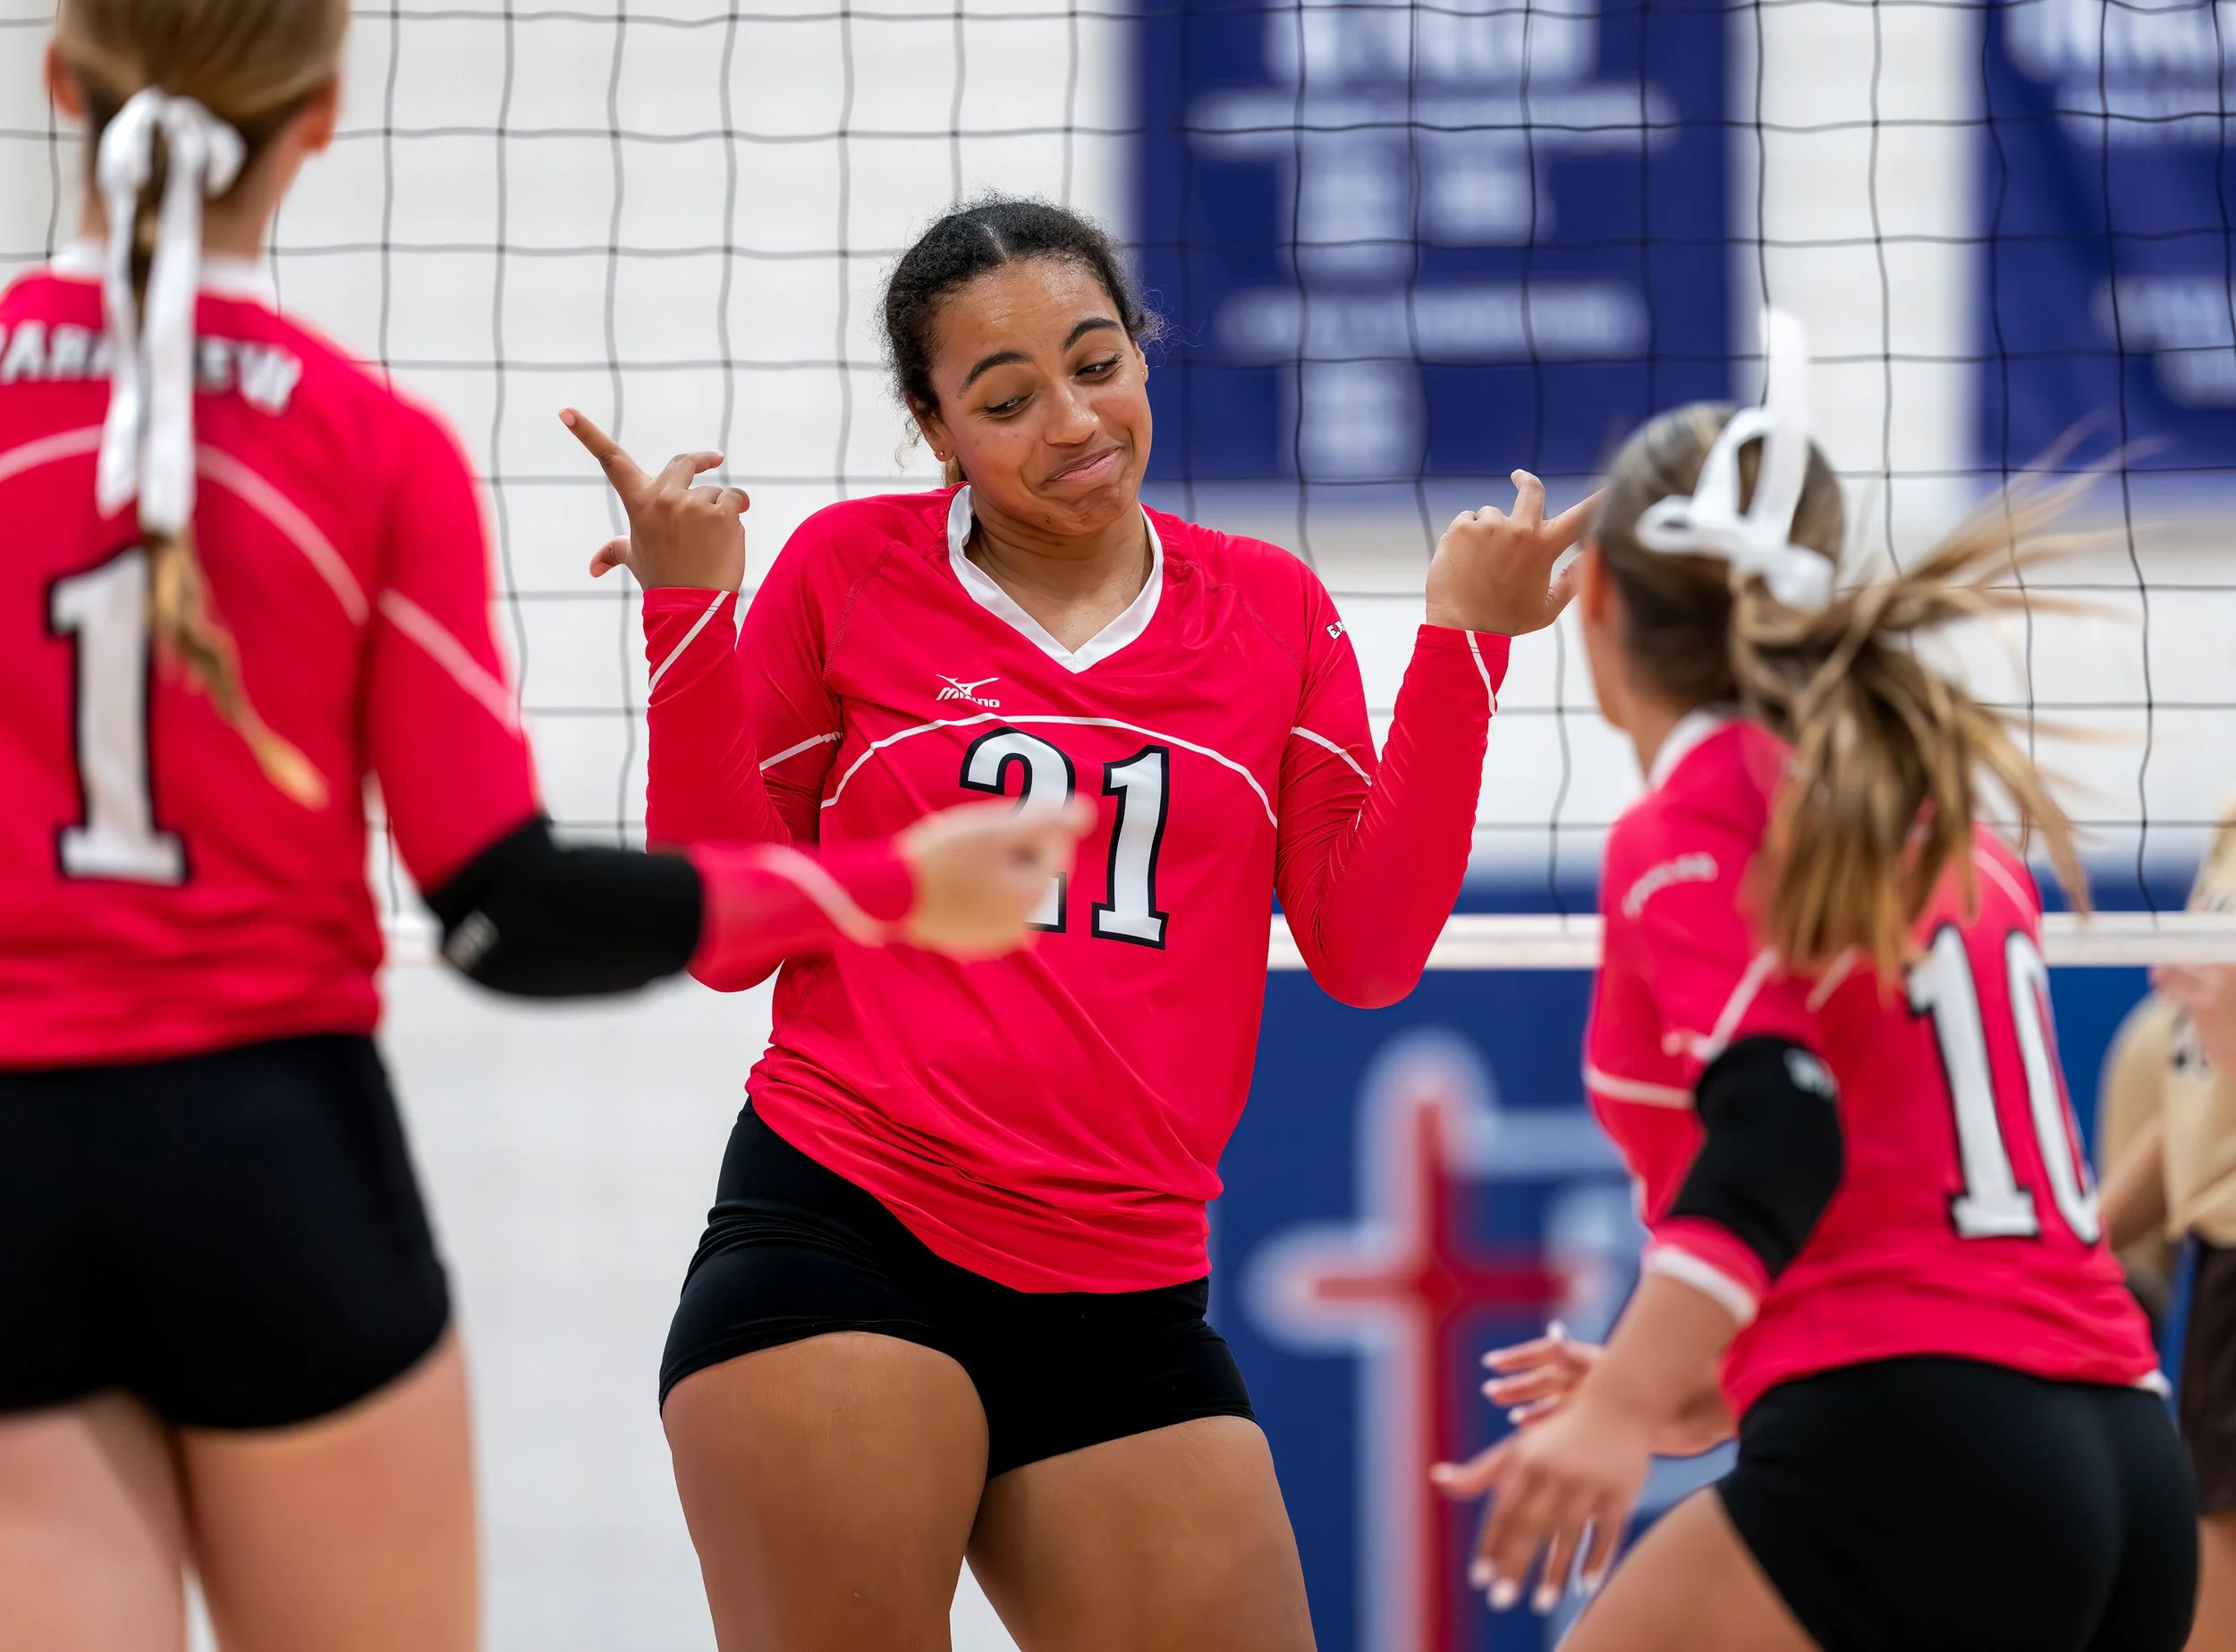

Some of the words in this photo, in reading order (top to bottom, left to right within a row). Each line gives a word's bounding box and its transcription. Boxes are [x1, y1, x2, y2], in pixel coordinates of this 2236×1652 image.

[47, 537, 190, 887] 1
[959, 726, 1170, 951] 21
[1905, 922, 2100, 1245] 10
